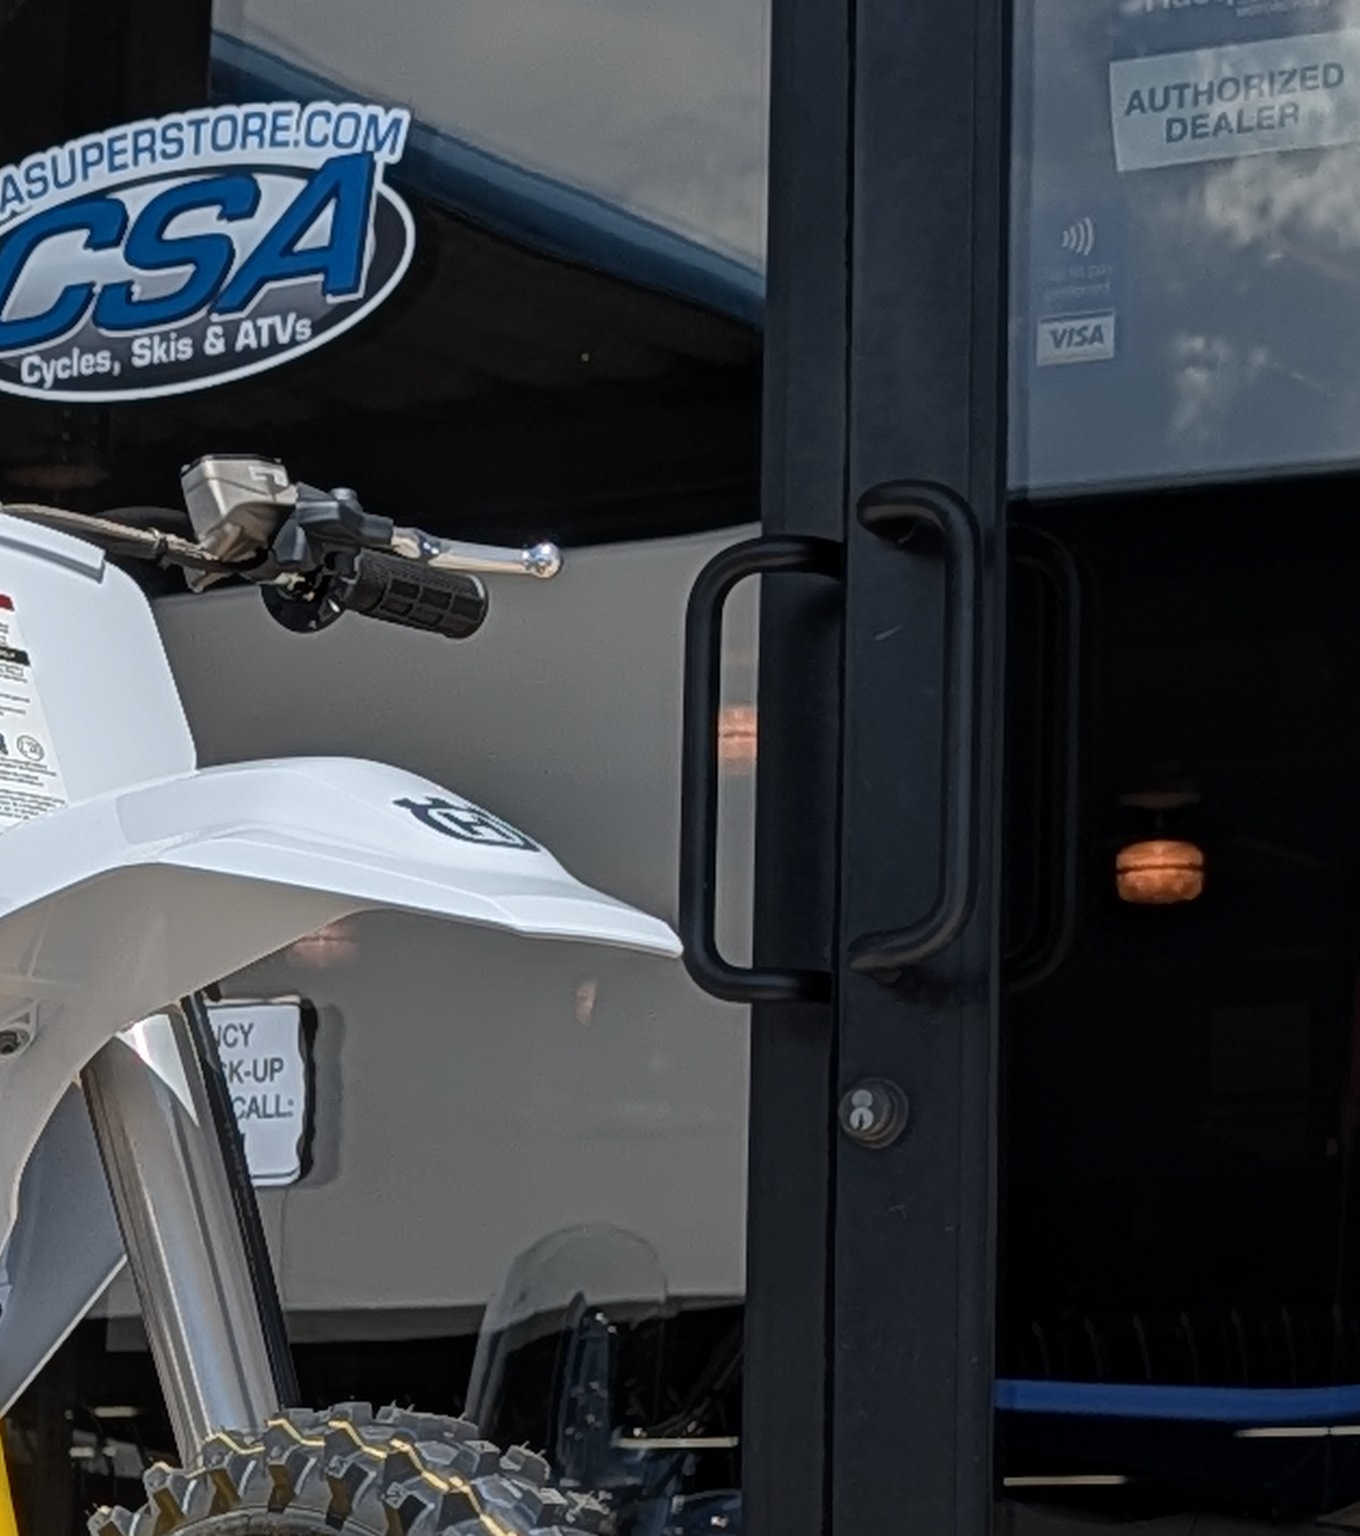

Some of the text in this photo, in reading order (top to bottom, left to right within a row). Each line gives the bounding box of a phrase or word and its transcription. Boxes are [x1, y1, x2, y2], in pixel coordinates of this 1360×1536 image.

[1124, 62, 1345, 116] AUTHORIZED
[1165, 101, 1300, 144] DEALER
[20, 312, 312, 389] Cycles, Skis & ATVs
[1049, 324, 1106, 349] VISA
